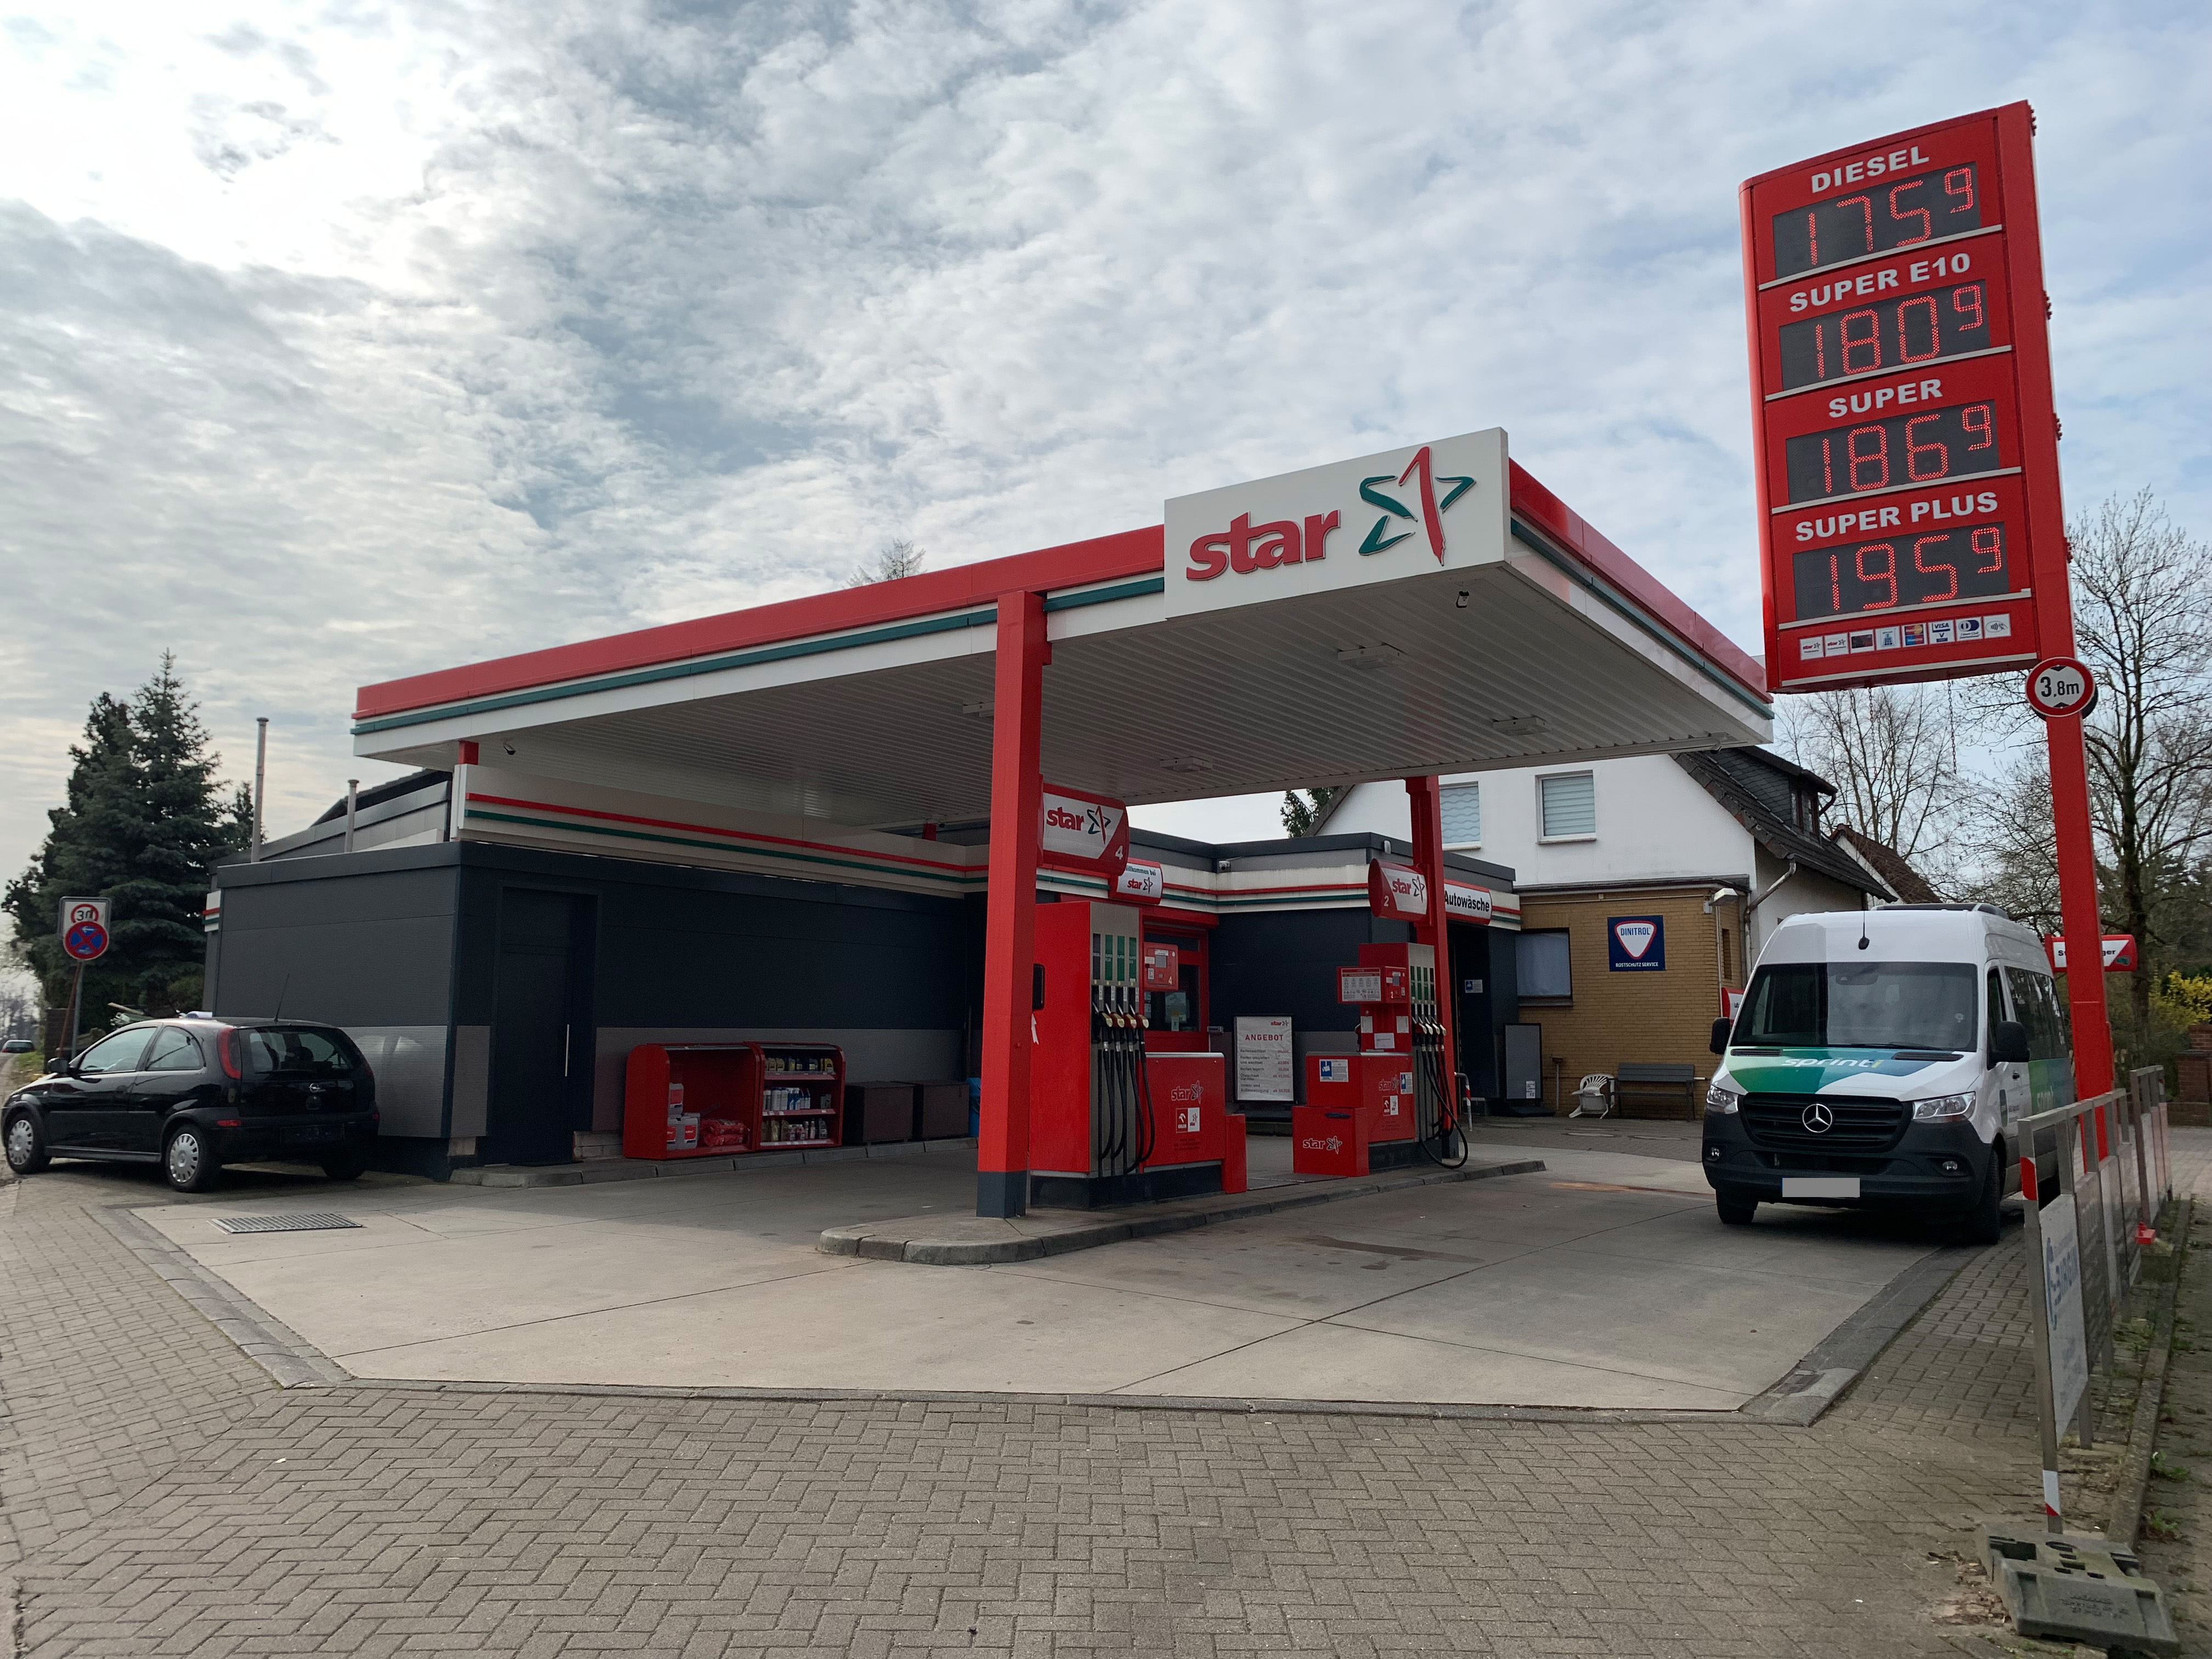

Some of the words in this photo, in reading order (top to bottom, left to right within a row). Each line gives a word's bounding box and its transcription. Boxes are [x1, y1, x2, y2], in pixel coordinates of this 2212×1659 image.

[1811, 146, 1929, 193] DIESEL
[1790, 269, 1899, 312] SUPER
[1910, 253, 1970, 283] E10
[1829, 379, 1943, 418] SUPER
[1796, 506, 1900, 541] SUPER
[1911, 492, 1998, 522] PLUS
[1187, 509, 1340, 580] star
[2040, 676, 2079, 697] 3,8m
[1047, 806, 1085, 831] star
[1115, 845, 1124, 860] 4
[1127, 878, 1142, 889] star
[1392, 878, 1411, 895] star
[1384, 895, 1389, 907] 2
[1444, 890, 1489, 912] Autowäsche
[1621, 927, 1650, 936] DINITROL
[1169, 976, 1172, 985] 4
[1781, 1058, 1884, 1069] sprinti
[1379, 1079, 1392, 1091] star
[1171, 1086, 1190, 1101] star
[1303, 1138, 1325, 1149] star
